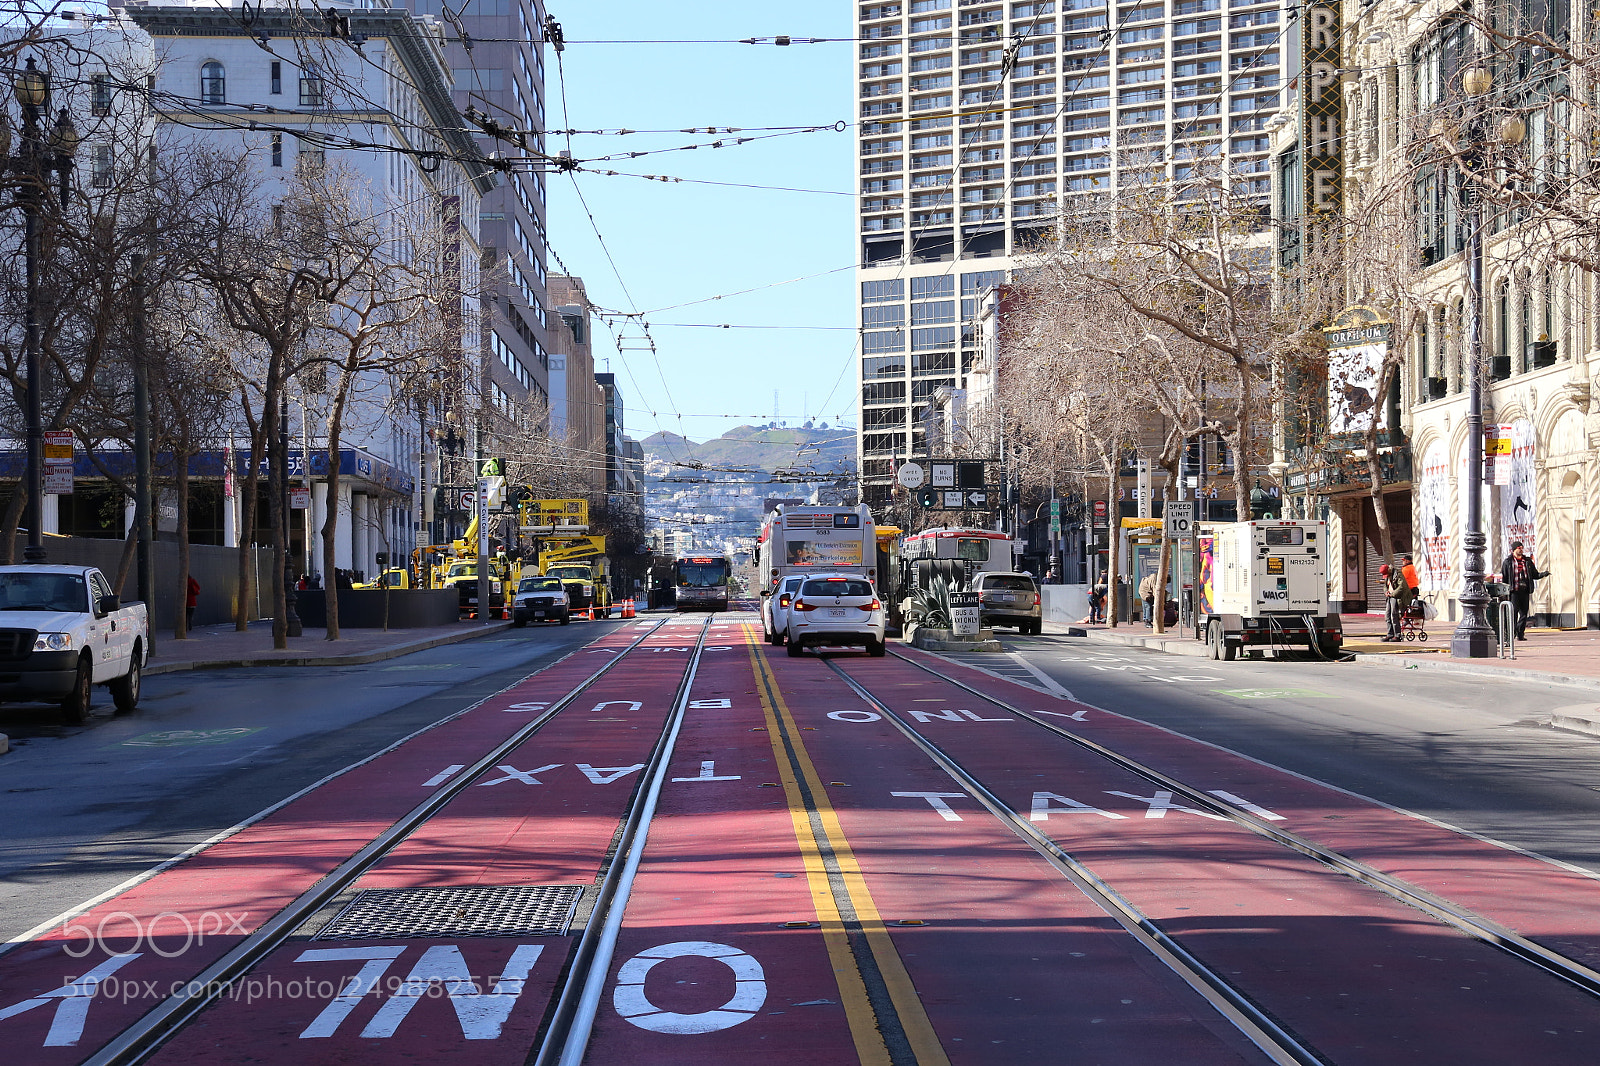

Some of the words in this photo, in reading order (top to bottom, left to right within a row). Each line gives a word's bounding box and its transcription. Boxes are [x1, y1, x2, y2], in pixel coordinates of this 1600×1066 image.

[45, 466, 53, 474] NO
[244, 456, 305, 470] CHSE
[843, 516, 849, 524] 7
[1172, 518, 1188, 531] 10
[1424, 553, 1451, 571] MUSICAL
[950, 596, 963, 604] LEFT
[963, 616, 978, 624] ONLY
[502, 698, 732, 712] BUS
[826, 708, 1091, 723] ONLY
[421, 760, 742, 787] TAXI
[889, 789, 1288, 822] TAXI
[0, 940, 768, 1048] ONLY
